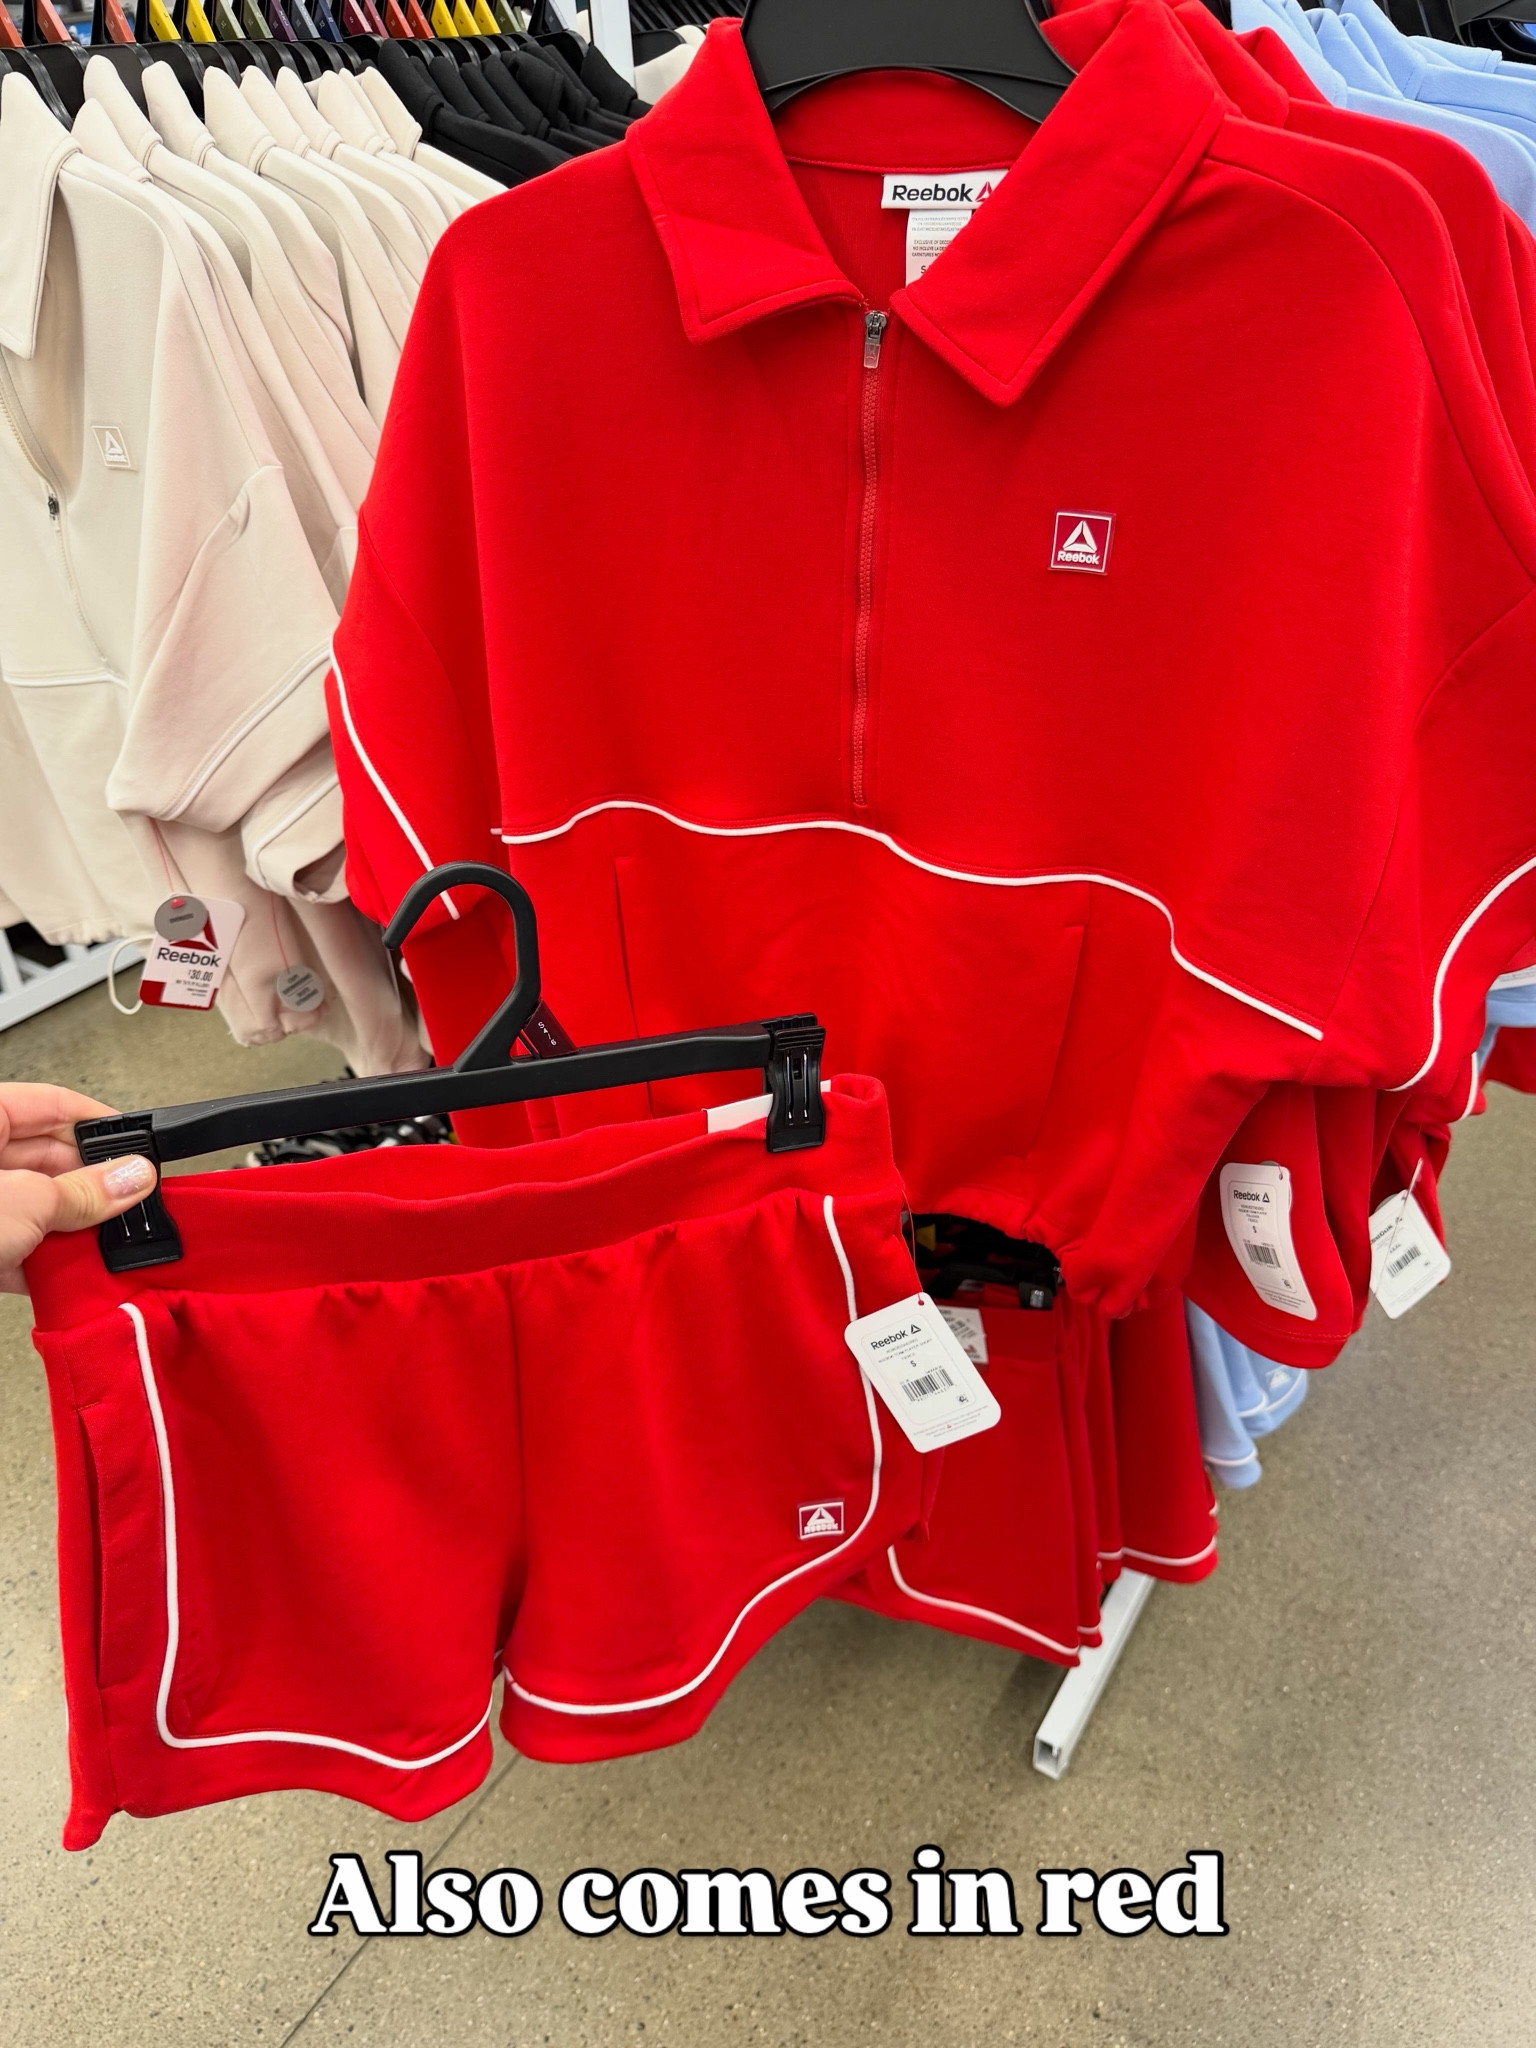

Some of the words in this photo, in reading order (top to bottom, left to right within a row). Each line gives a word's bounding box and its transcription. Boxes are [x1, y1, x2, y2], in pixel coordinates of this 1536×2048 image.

[891, 183, 974, 203] Reebok
[1057, 550, 1100, 565] Reebok
[157, 947, 222, 967] Reebok
[1233, 1189, 1260, 1201] Reebok
[870, 1329, 908, 1350] Reebok
[910, 1360, 917, 1368] S
